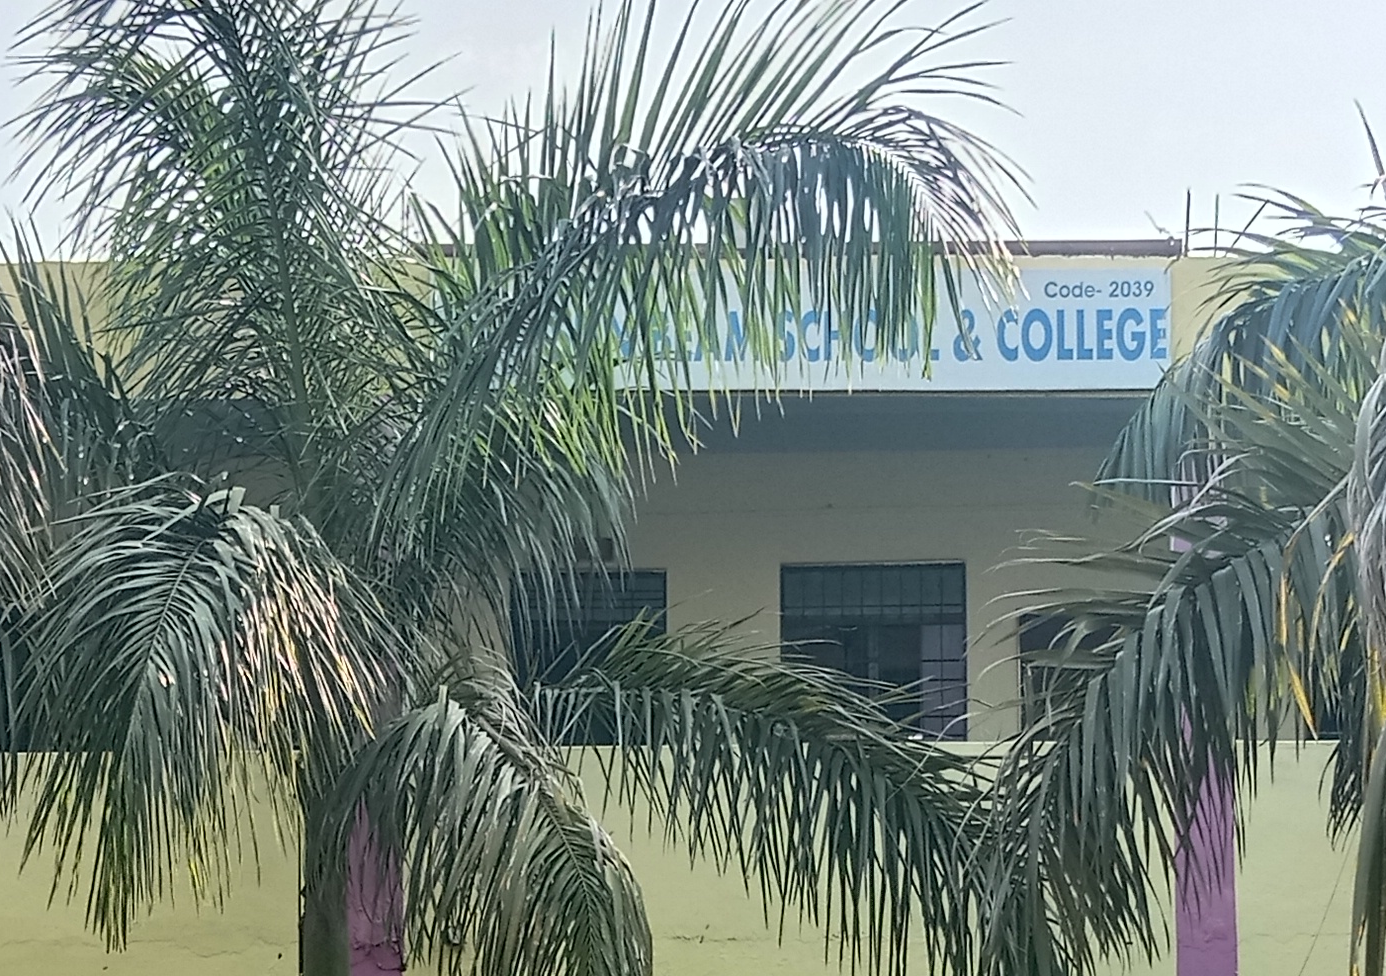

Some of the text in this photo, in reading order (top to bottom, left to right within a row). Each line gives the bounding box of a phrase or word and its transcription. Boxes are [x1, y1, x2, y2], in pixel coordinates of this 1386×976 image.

[1044, 281, 1154, 298] Code- 2039
[953, 309, 983, 362] &
[997, 308, 1167, 362] COLLEGE
